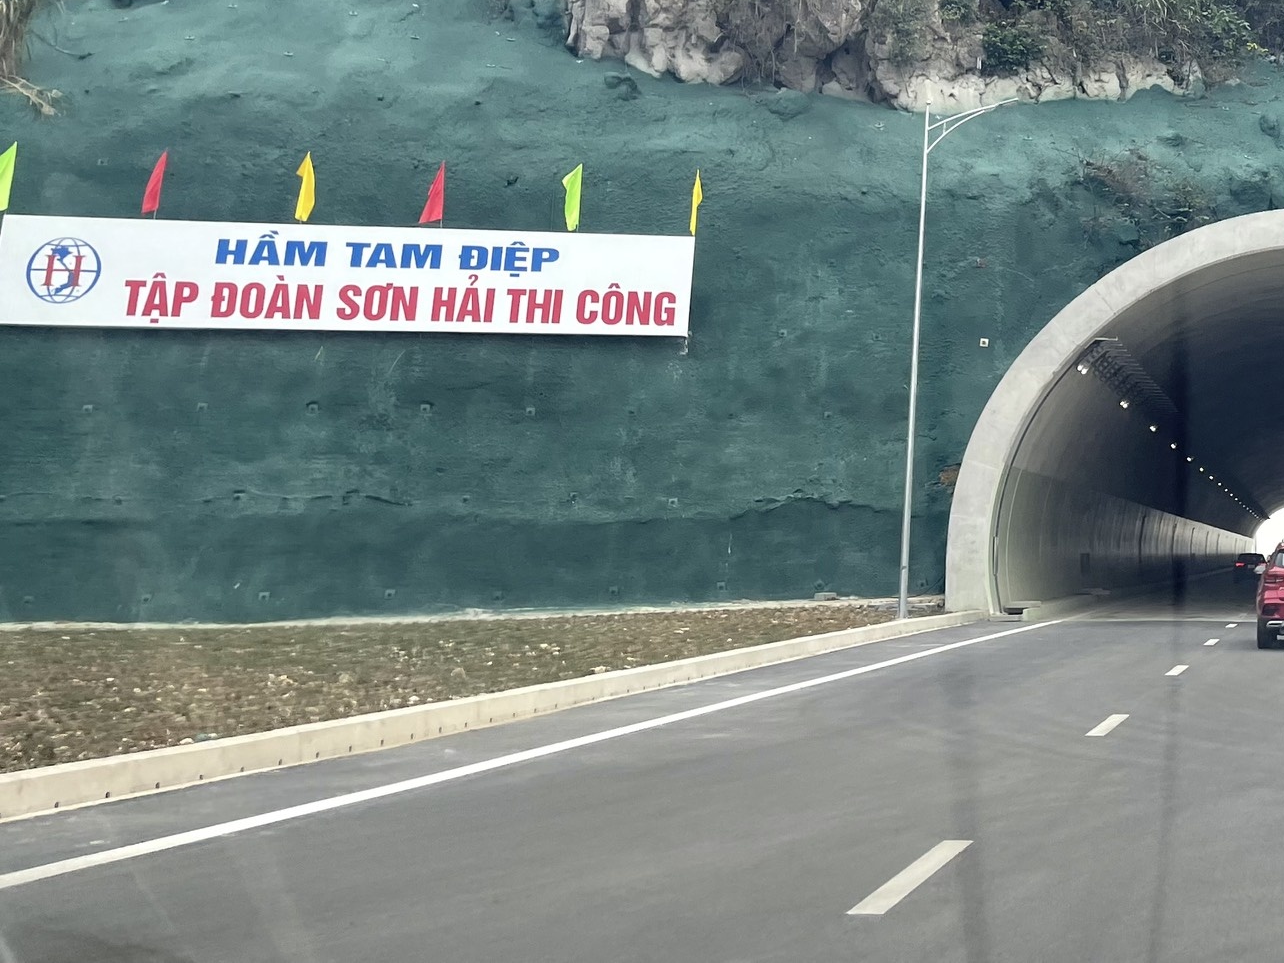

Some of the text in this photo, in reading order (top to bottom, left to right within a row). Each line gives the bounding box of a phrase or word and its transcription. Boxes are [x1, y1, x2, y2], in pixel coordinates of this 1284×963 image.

[215, 230, 560, 277] HẦM TAM ĐIỆP
[124, 272, 676, 326] TẬP ĐOÀN SƠN HẢI THI CÔNG
